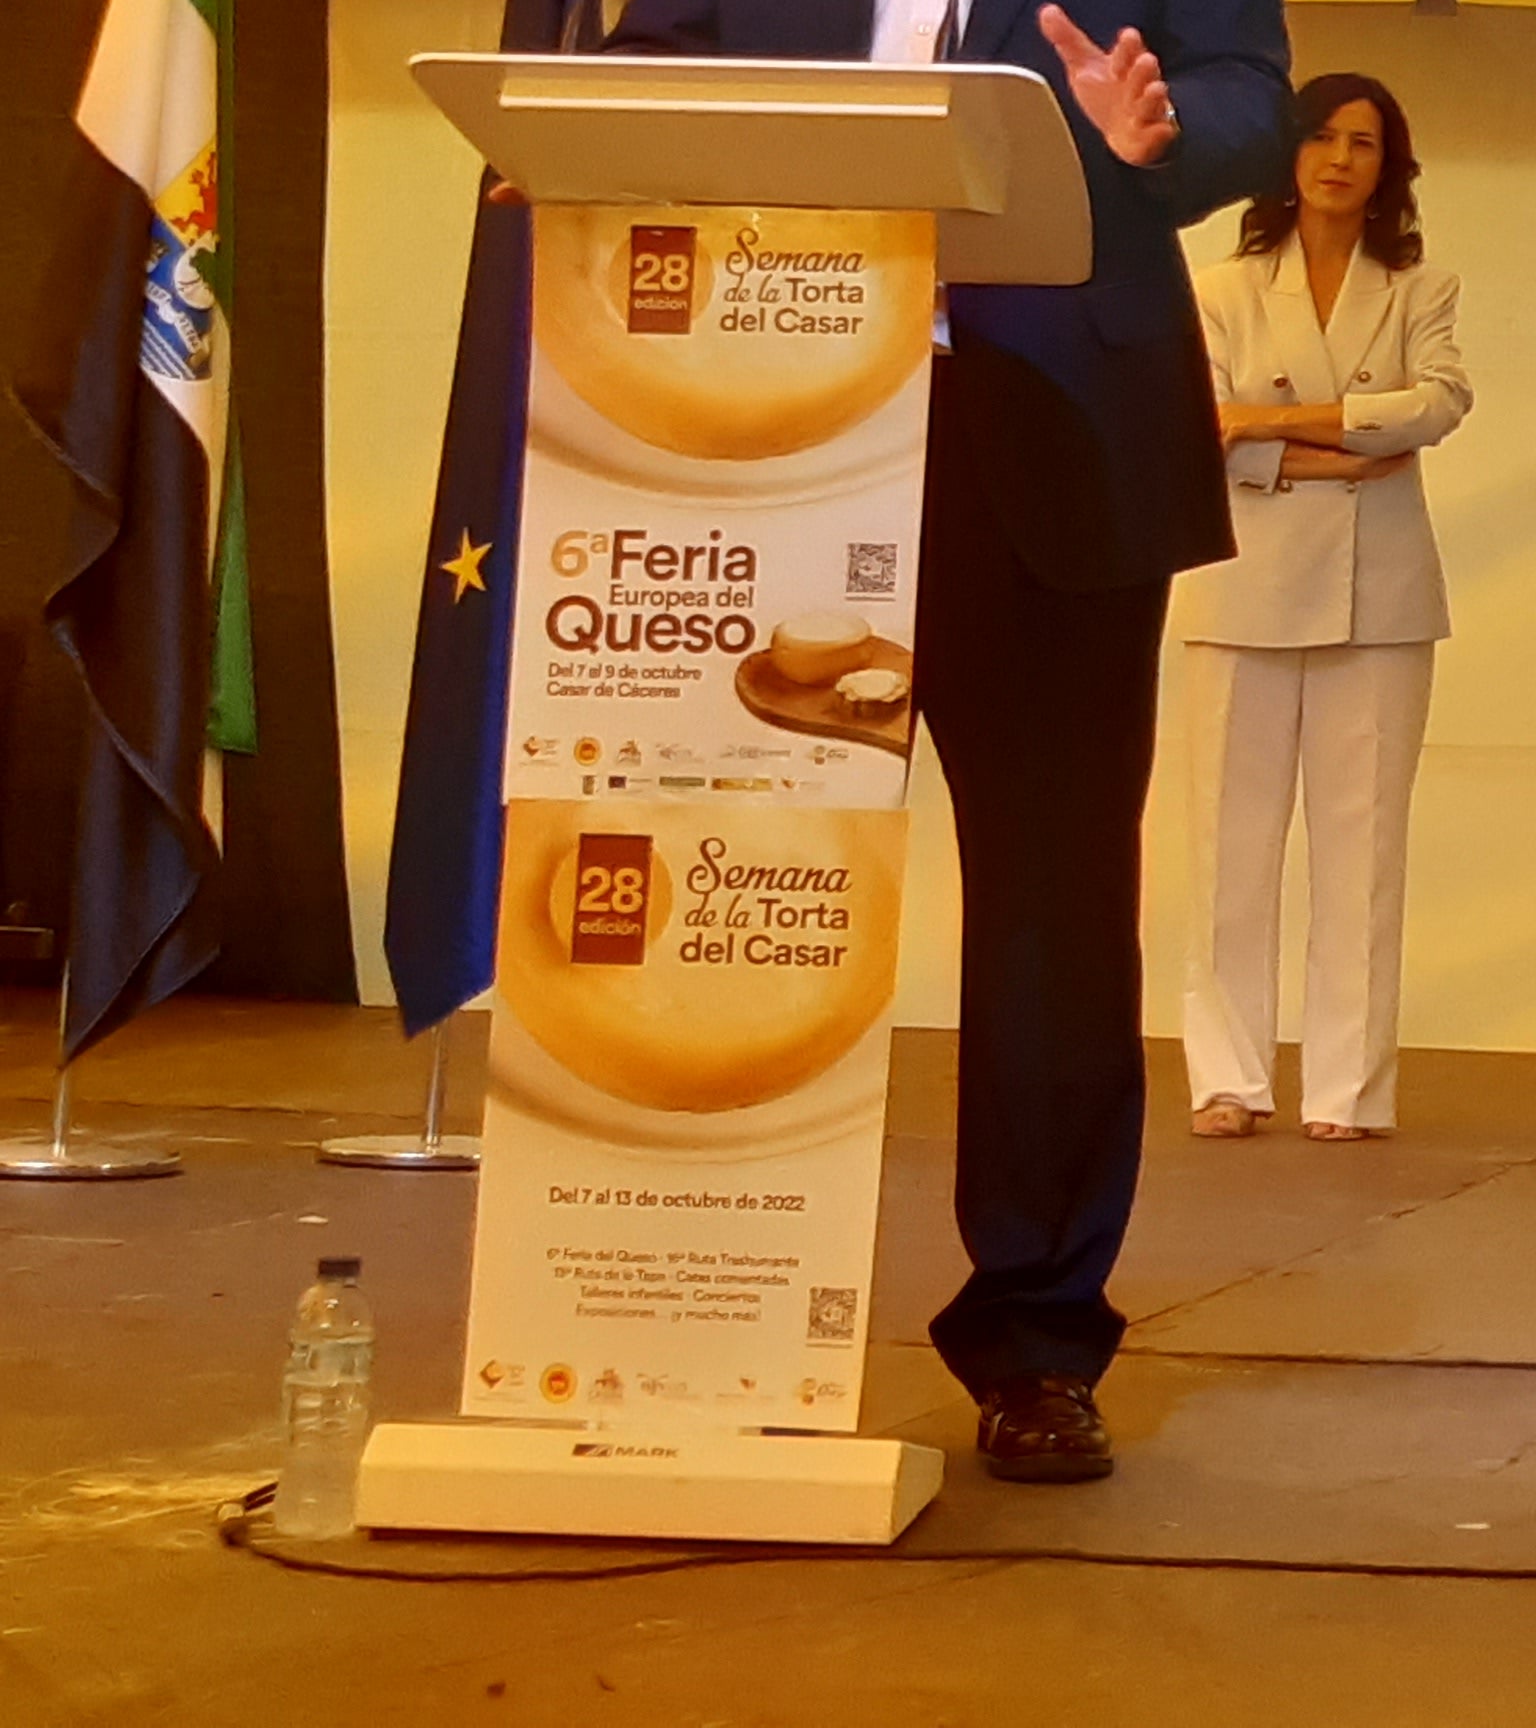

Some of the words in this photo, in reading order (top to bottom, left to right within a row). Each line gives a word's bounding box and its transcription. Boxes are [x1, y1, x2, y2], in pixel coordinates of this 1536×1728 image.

[725, 227, 865, 274] Semana
[634, 253, 690, 292] 28
[724, 272, 751, 303] de
[757, 273, 782, 304] la
[786, 278, 864, 305] Torta
[719, 307, 766, 333] del
[774, 308, 864, 335] Casar
[550, 529, 608, 578] 6ª
[610, 529, 757, 582] Feria
[609, 584, 709, 610] Europea
[715, 586, 755, 609] del
[545, 595, 757, 655] Queso
[548, 662, 575, 679] Del
[577, 664, 586, 679] 7
[588, 663, 602, 680] al
[605, 664, 616, 680] 9
[618, 664, 638, 680] de
[641, 665, 702, 681] octubre
[547, 682, 590, 698] Casar
[594, 683, 614, 698] de
[686, 837, 853, 894] Semana
[578, 867, 644, 913] 28
[579, 917, 642, 935] edición
[684, 890, 719, 928] de
[725, 892, 751, 929] la
[756, 897, 849, 930] Torta
[679, 933, 735, 964] del
[743, 934, 849, 967] Casar
[549, 1186, 578, 1204] Del
[580, 1188, 592, 1204] 7
[595, 1188, 611, 1205] al
[614, 1190, 632, 1206] 13
[635, 1190, 658, 1207] de
[662, 1191, 732, 1210] octubre
[736, 1193, 758, 1210] de
[762, 1195, 806, 1212] 2022
